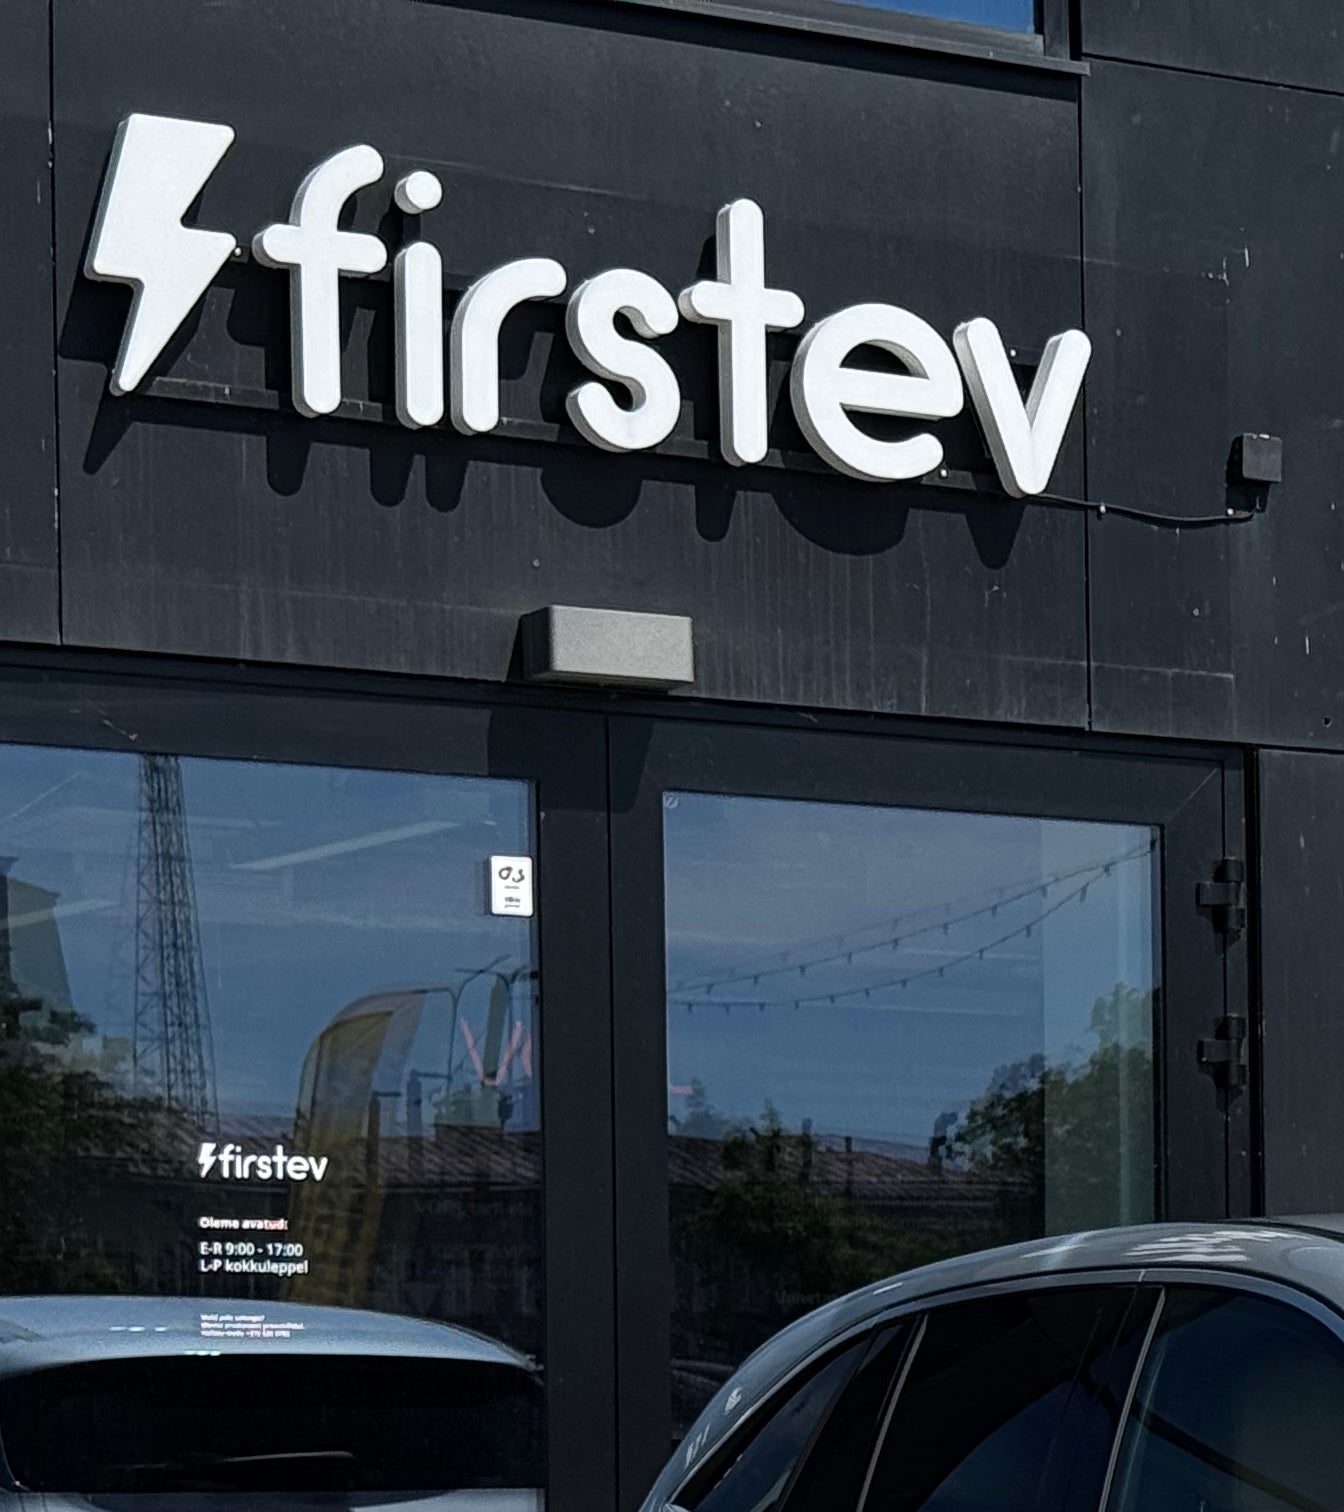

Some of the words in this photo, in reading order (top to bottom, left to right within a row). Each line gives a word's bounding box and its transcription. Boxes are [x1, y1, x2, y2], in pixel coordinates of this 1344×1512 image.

[252, 143, 1092, 499] firstev
[218, 1143, 328, 1182] firstev
[200, 1241, 222, 1256] E-R
[225, 1242, 255, 1257] 9:00
[266, 1243, 304, 1257] 17:00
[200, 1259, 222, 1273] L-P
[225, 1259, 309, 1277] kokkuleppel
